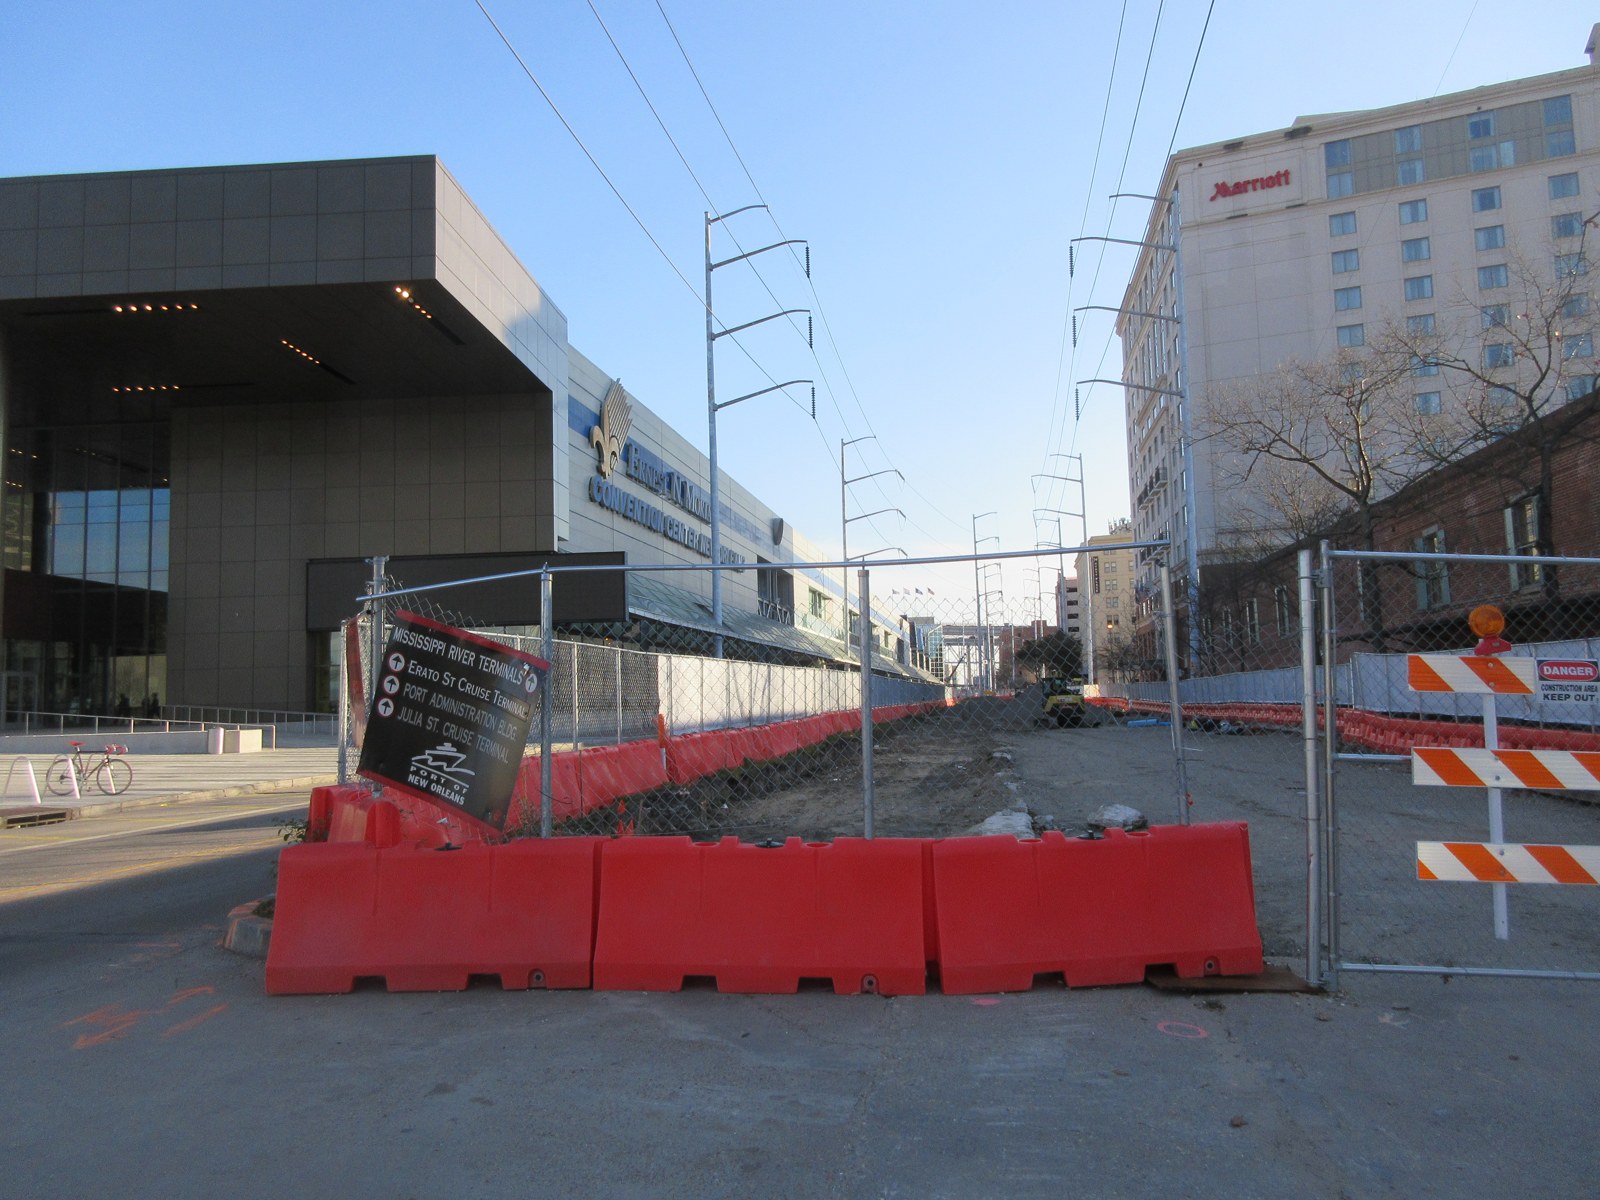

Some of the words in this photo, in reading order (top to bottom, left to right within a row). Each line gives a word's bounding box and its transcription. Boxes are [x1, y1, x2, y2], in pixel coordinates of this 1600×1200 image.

[1209, 169, 1290, 201] Marriott
[626, 442, 670, 497] ERNEST
[588, 475, 665, 536] CONVENTION
[665, 514, 700, 554] CENTER
[392, 626, 447, 657] MISSISSIPPI
[447, 644, 476, 667] RIVER
[478, 654, 523, 686] TERMINALS
[1543, 666, 1594, 676] DANGER
[402, 682, 429, 703] PORT
[429, 692, 498, 732] ADMINISTRATION
[407, 659, 440, 682] ERATO
[441, 671, 456, 687] ST
[457, 677, 491, 702] CRUISE
[493, 689, 528, 719] TERMINAL
[1540, 684, 1582, 693] CONSTRUCTION
[1583, 684, 1599, 693] AREA
[1542, 693, 1571, 701] KEEP
[1574, 694, 1596, 702] OUT
[397, 706, 423, 728] JULIA
[425, 716, 440, 734] ST.
[442, 721, 475, 747] CRUISE
[476, 734, 509, 764] TERMINAL
[407, 773, 429, 788] NEW
[430, 782, 466, 806] ORLEANS
[410, 765, 447, 784] PORT
[453, 784, 468, 794] OF
